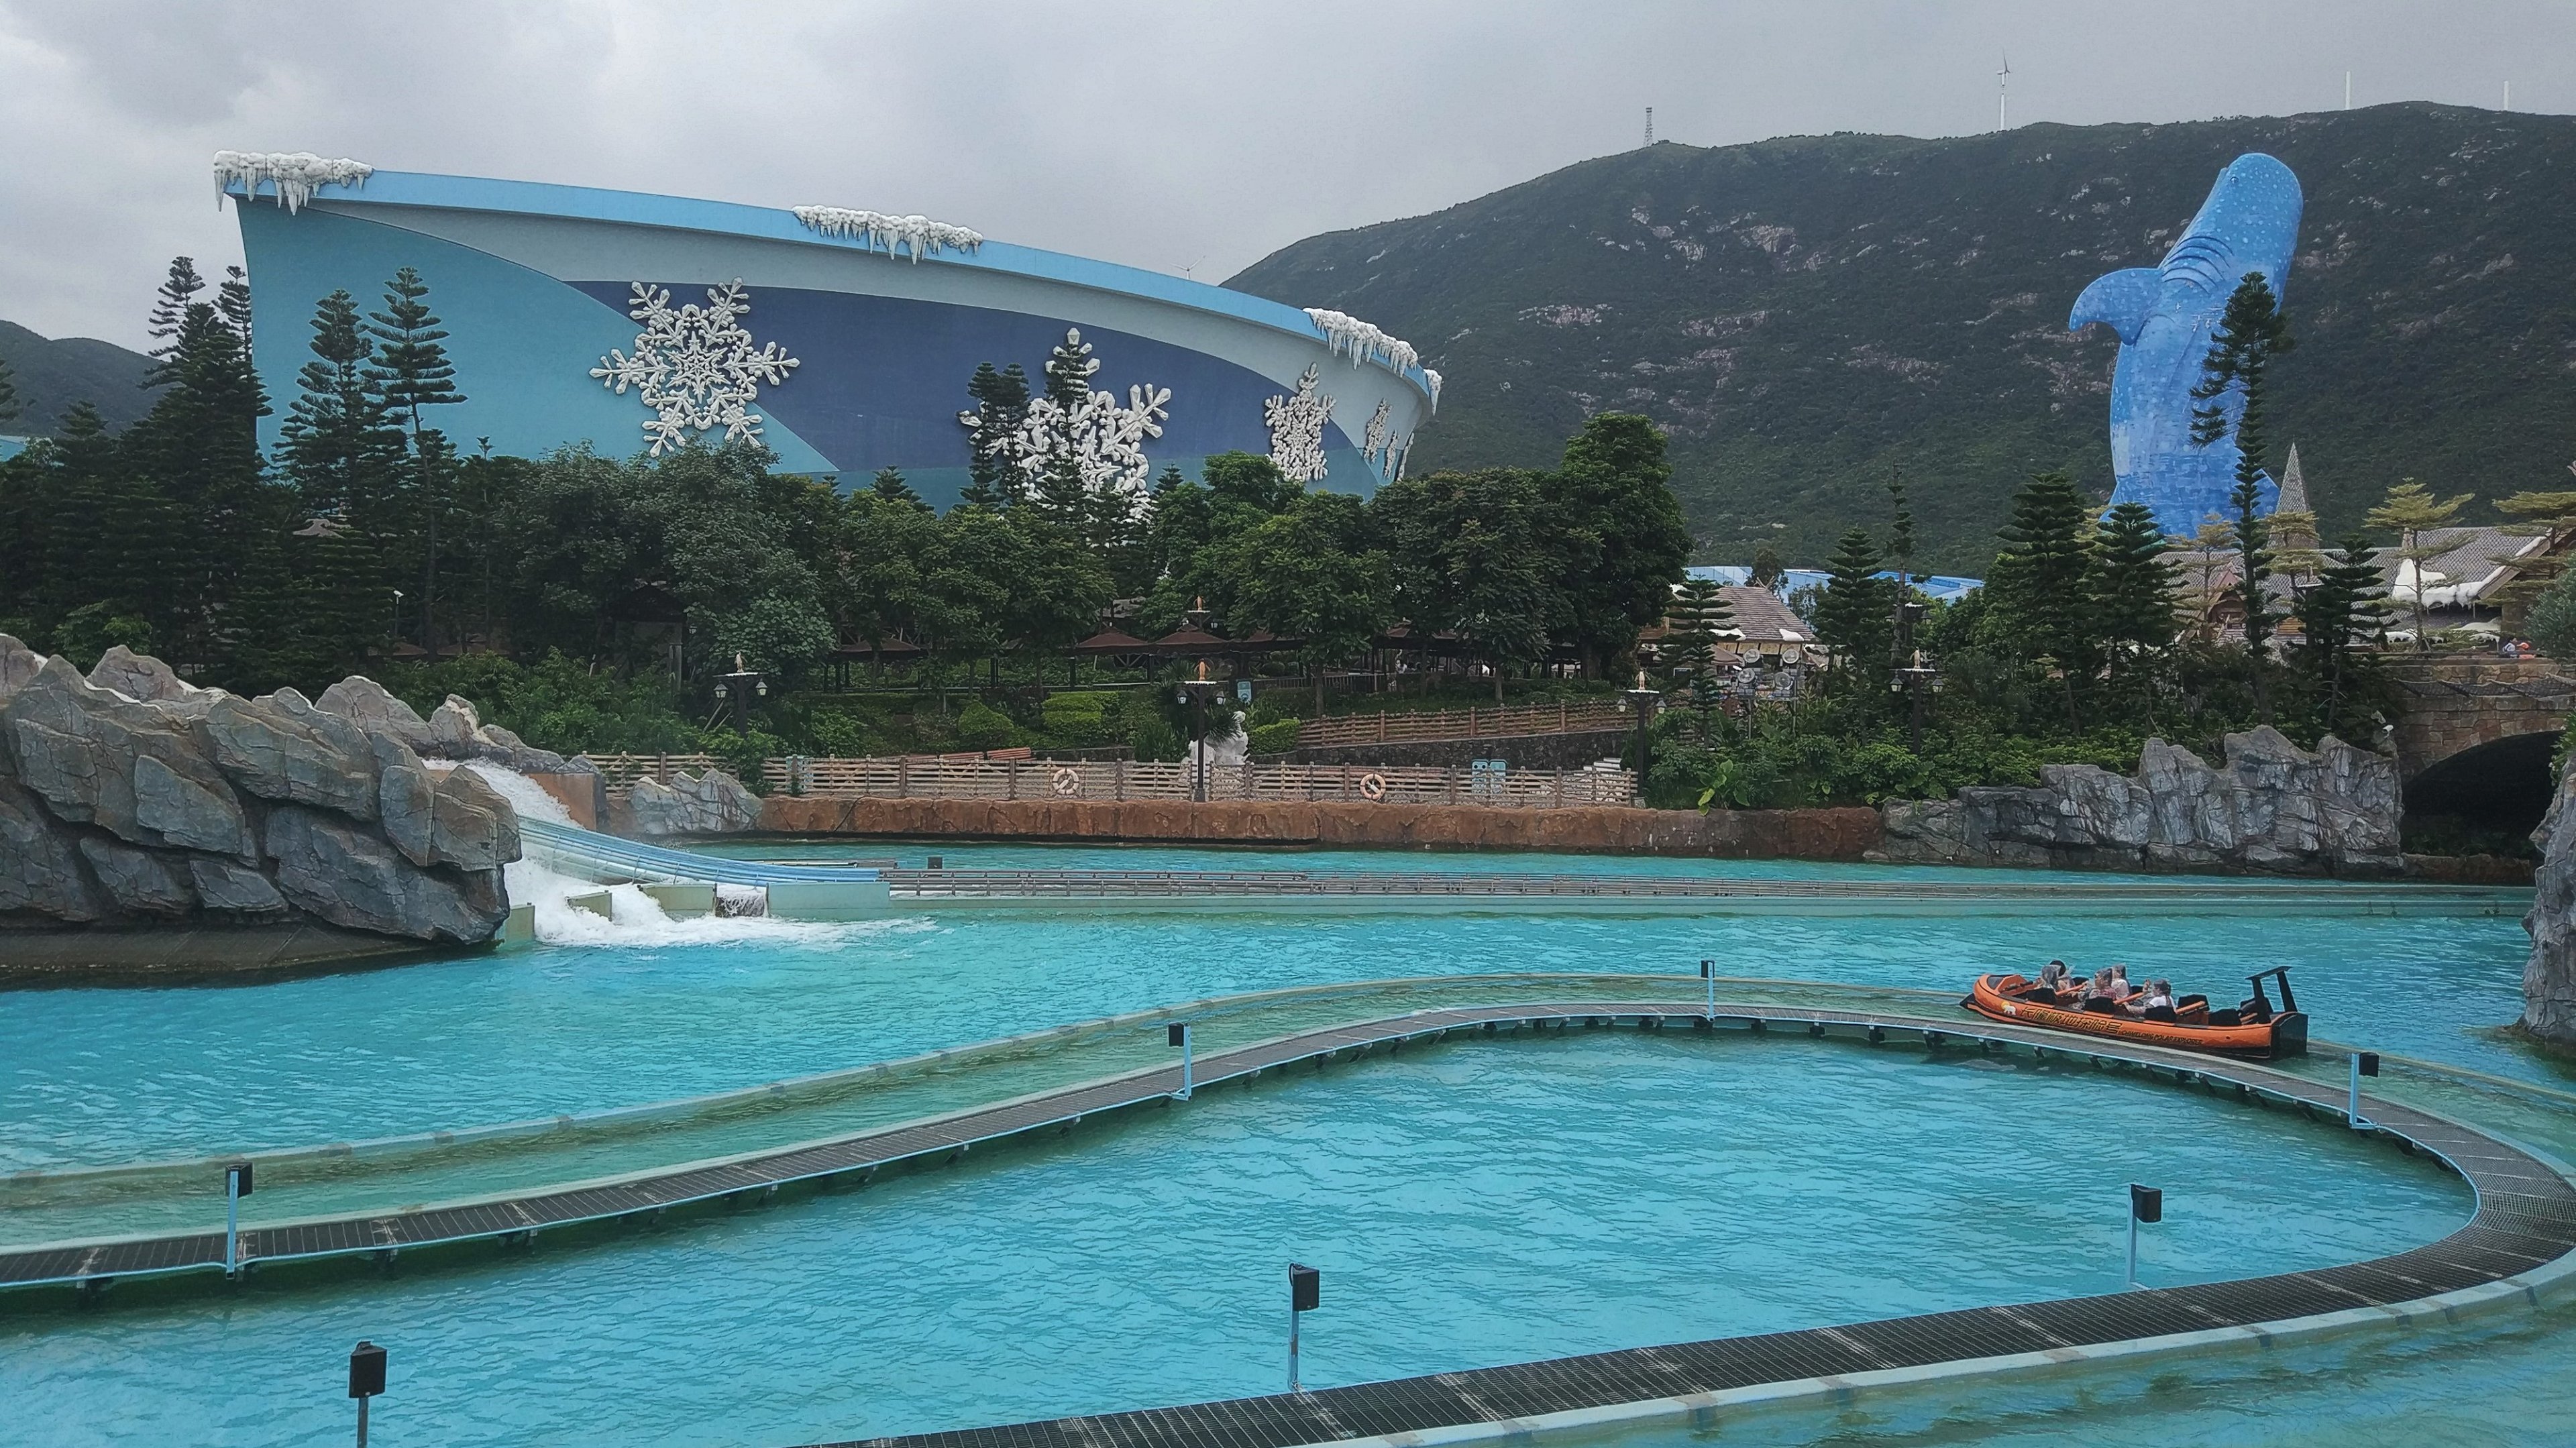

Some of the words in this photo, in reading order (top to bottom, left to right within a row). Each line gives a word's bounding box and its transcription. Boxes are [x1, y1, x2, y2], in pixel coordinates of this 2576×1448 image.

[2021, 1006, 2123, 1034] 长隆极地探险号
